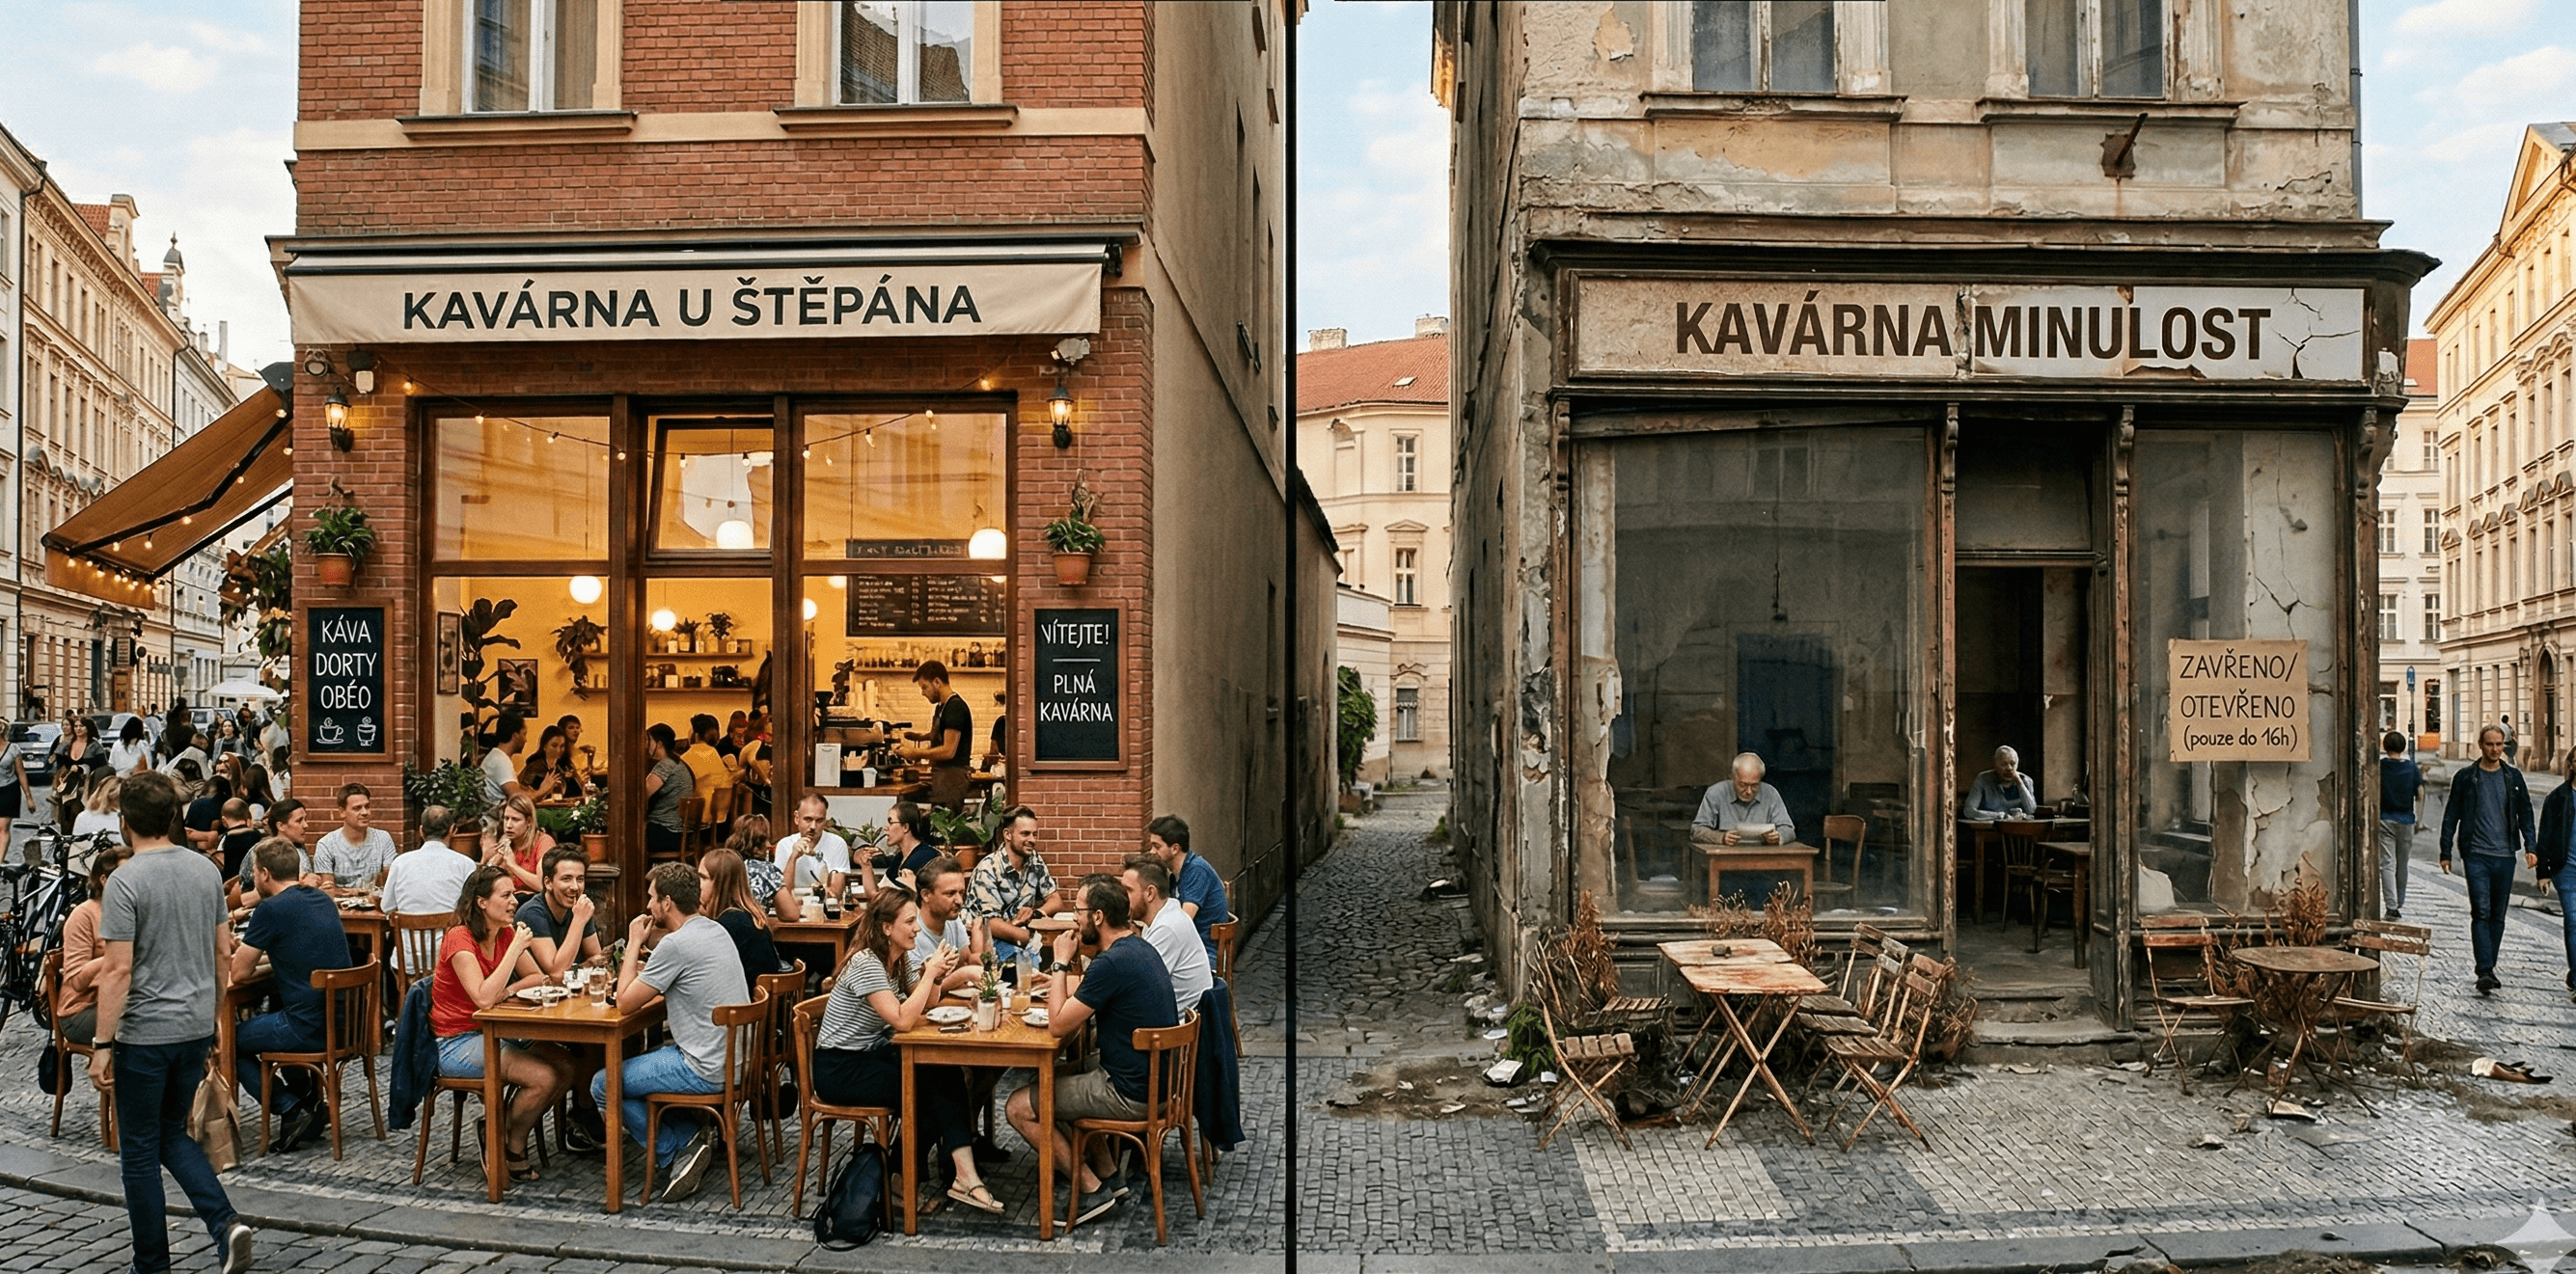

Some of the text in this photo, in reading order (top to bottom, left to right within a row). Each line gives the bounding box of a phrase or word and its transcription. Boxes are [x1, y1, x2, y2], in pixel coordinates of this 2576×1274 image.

[403, 273, 983, 330] KAVÁRNA U ŠTĚPÁNA
[1676, 289, 2272, 361] KAVÁRNA MINULOST
[321, 613, 372, 643] KÁVA
[1040, 618, 1110, 649] VÍTEJTE!
[315, 652, 377, 677] DORTY
[2179, 647, 2298, 683] ZAVŘENO/
[320, 678, 371, 710] OBÉO
[1054, 668, 1097, 694] PLNÁ
[1040, 696, 1113, 722] KAVÁRNA
[2180, 688, 2295, 718] OTEVŘENO
[2183, 724, 2298, 753] (pouze do 16h)
